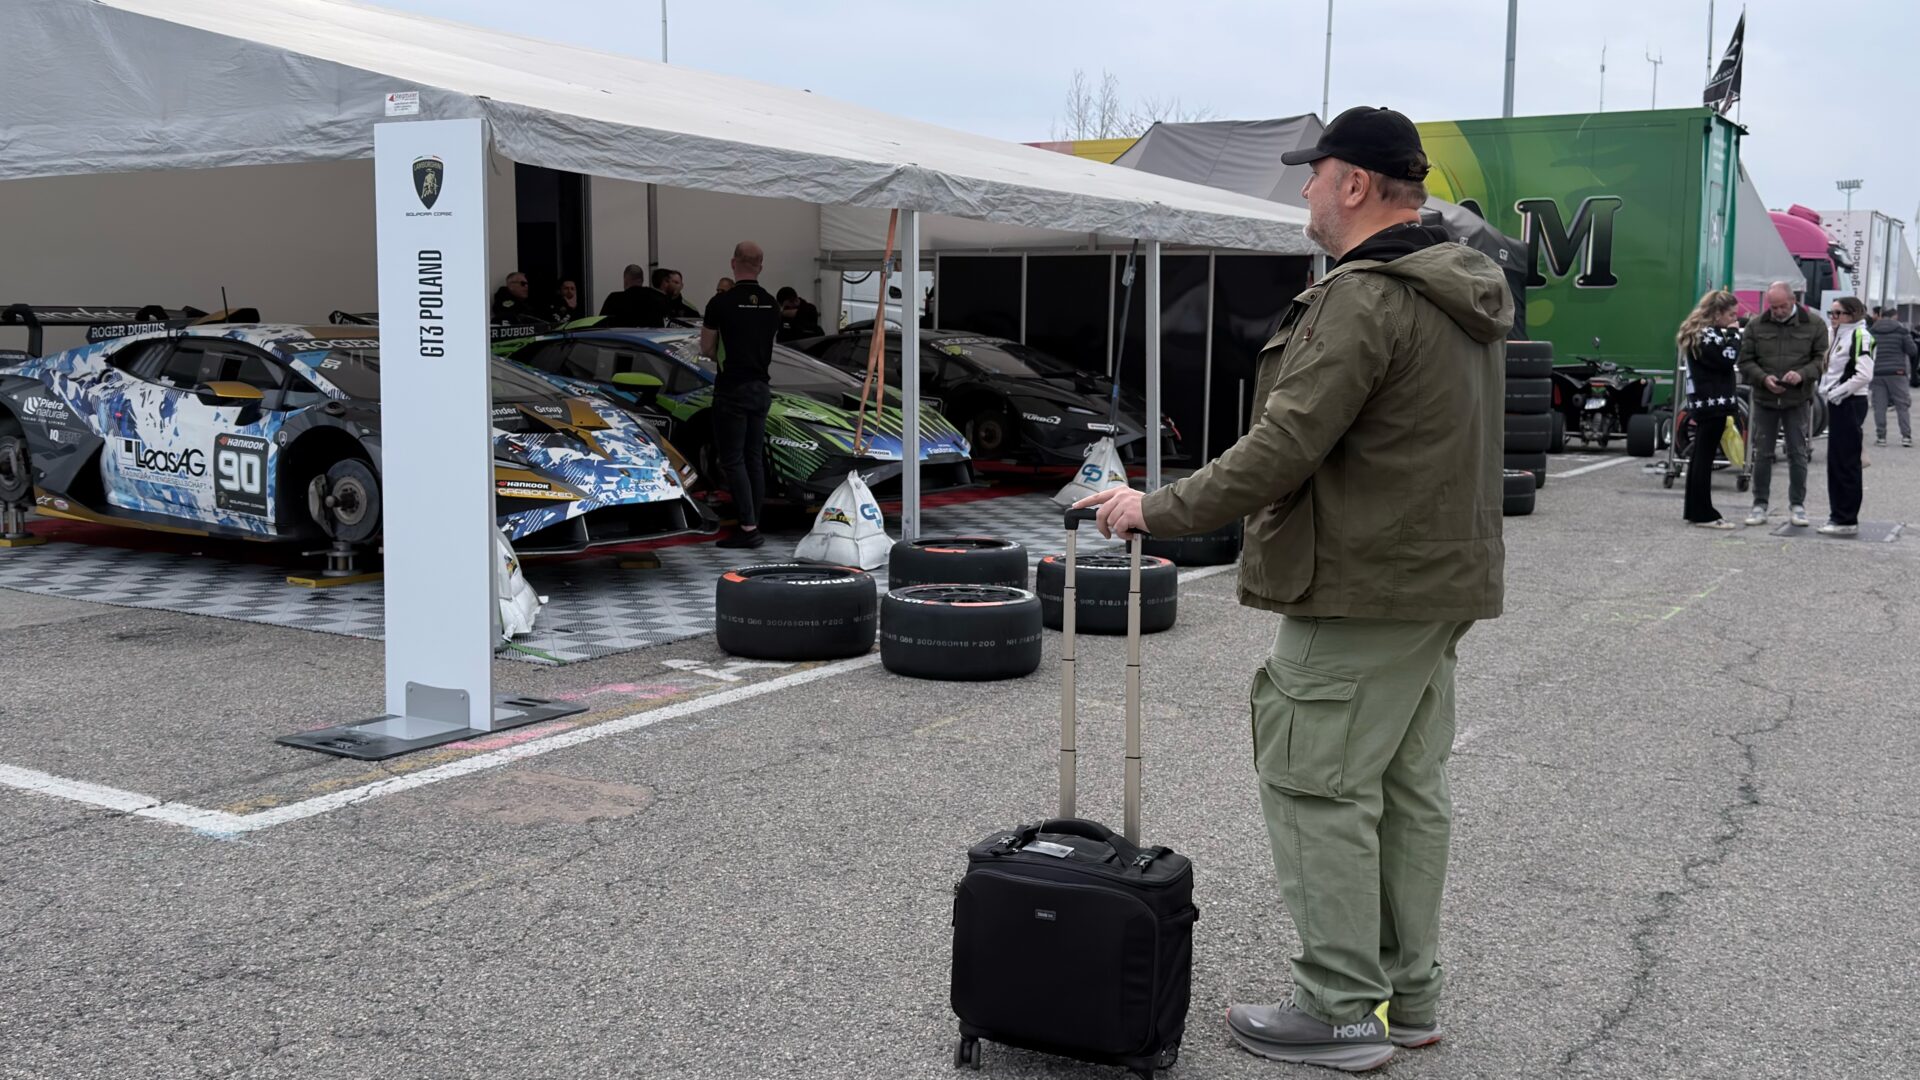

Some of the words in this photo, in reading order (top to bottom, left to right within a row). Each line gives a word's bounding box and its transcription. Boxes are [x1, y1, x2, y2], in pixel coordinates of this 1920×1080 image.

[418, 249, 443, 320] POLAND
[91, 325, 126, 338] ROGER
[420, 325, 445, 358] GT3
[218, 450, 261, 495] 90
[1333, 1022, 1377, 1039] HOKA
